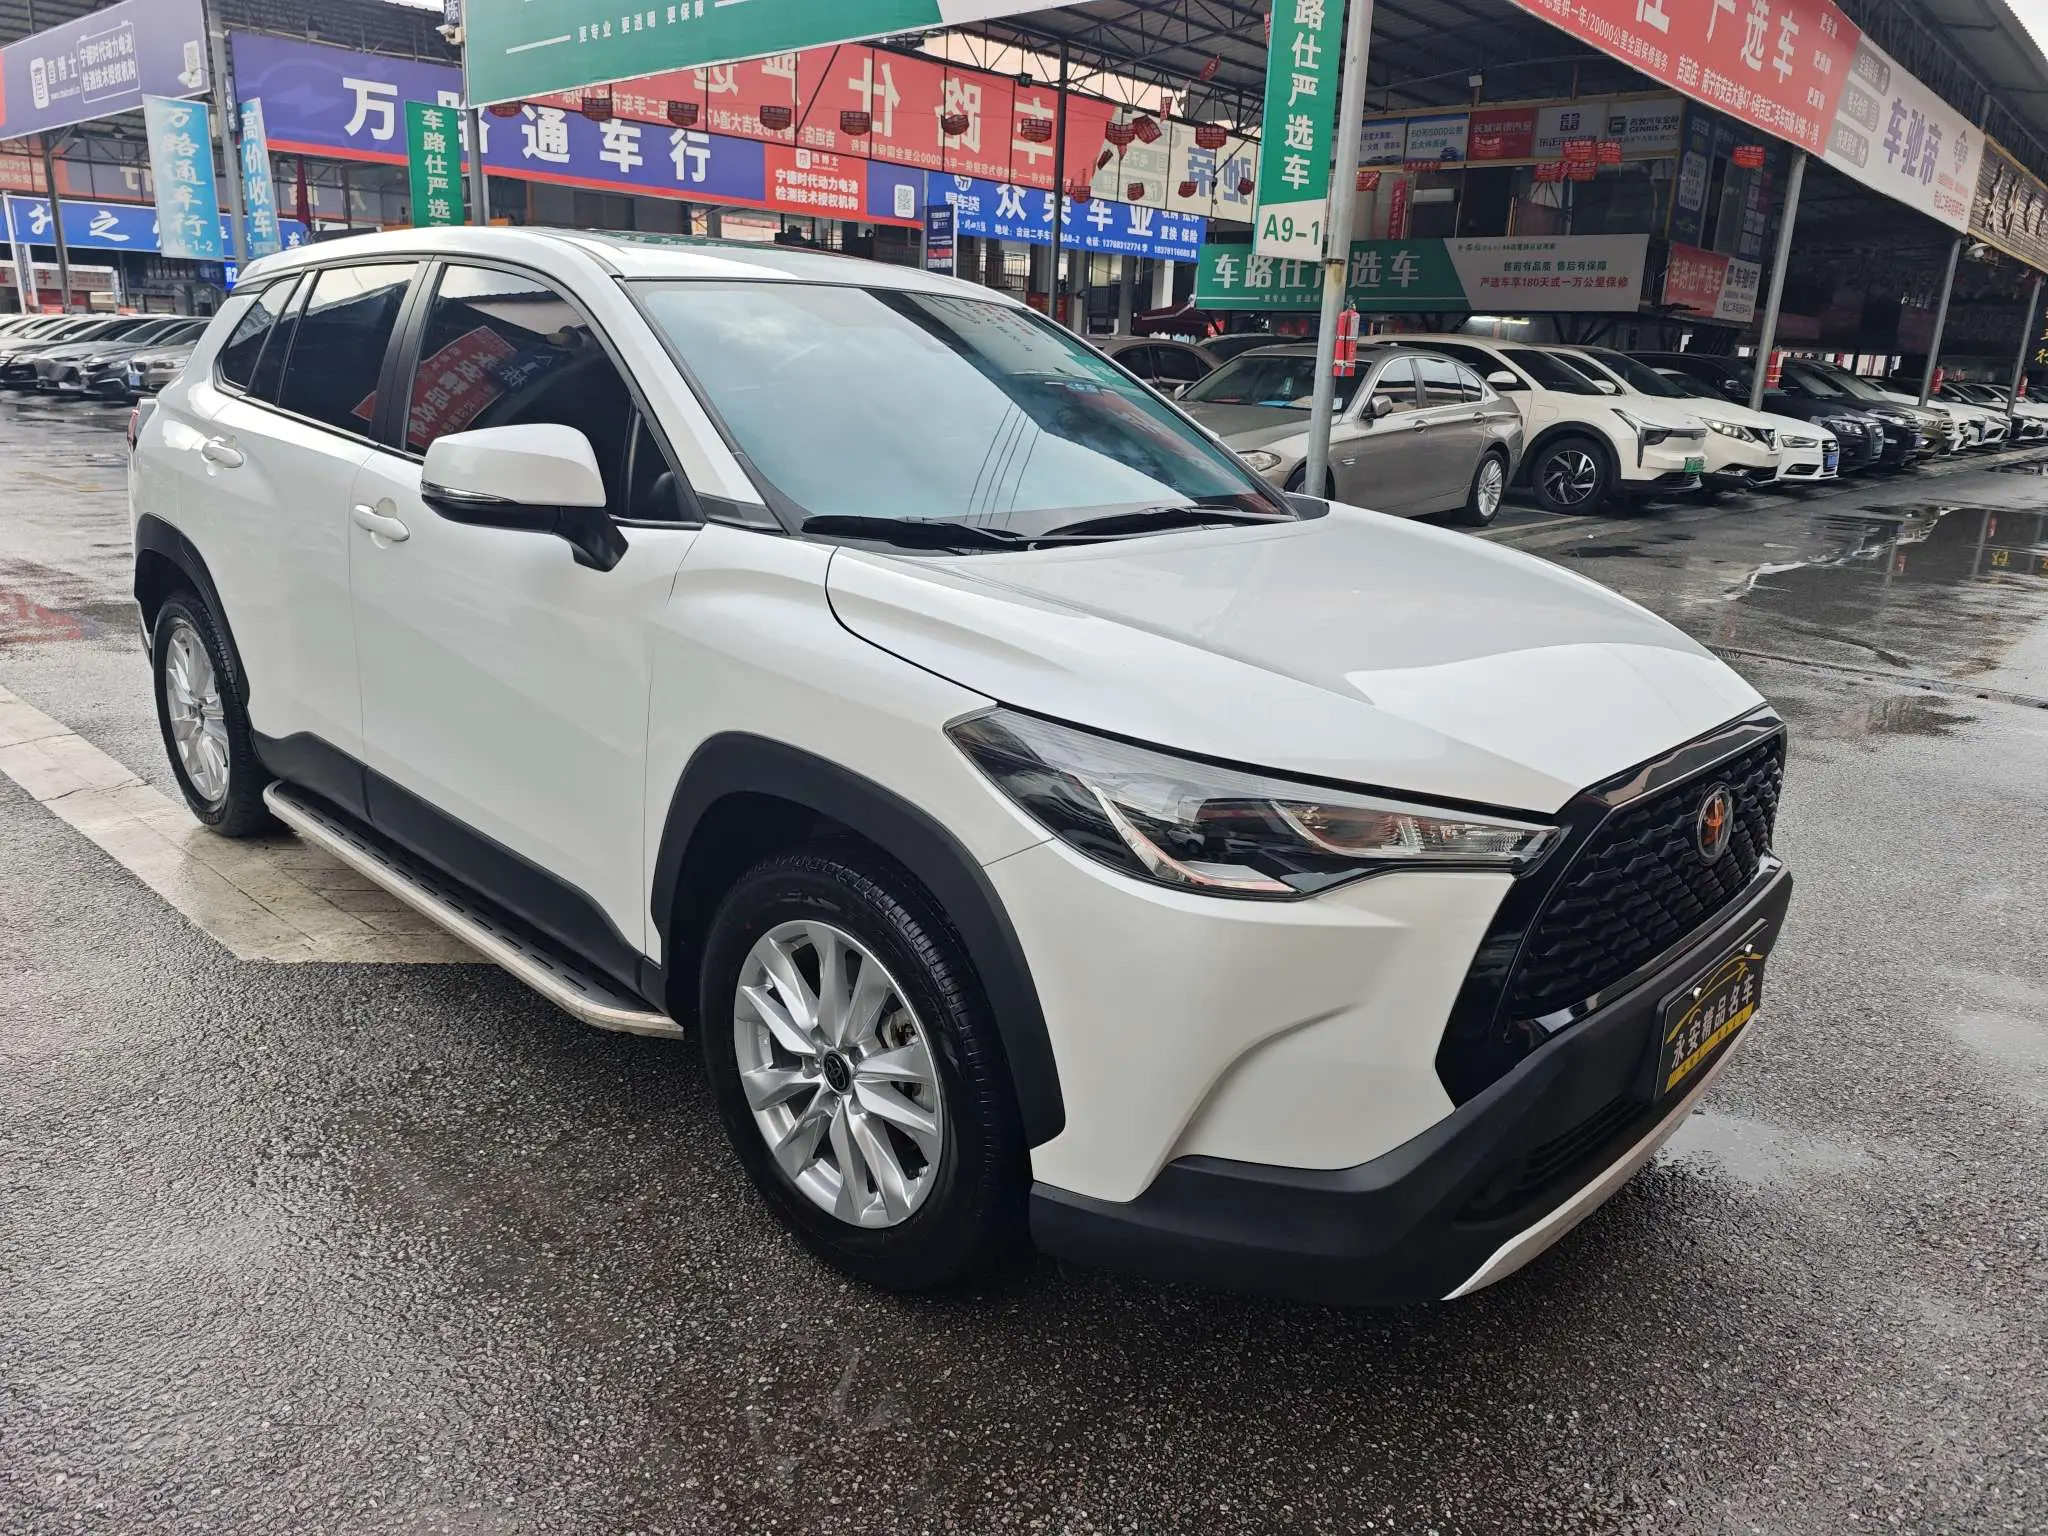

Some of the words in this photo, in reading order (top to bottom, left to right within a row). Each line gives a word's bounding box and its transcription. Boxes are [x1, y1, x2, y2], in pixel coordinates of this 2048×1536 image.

[422, 109, 450, 226] 车路仕严选
[775, 169, 859, 194] 宁德时代动力电池
[775, 186, 859, 211] 检测技术授权机构
[1263, 213, 1320, 245] A9-1
